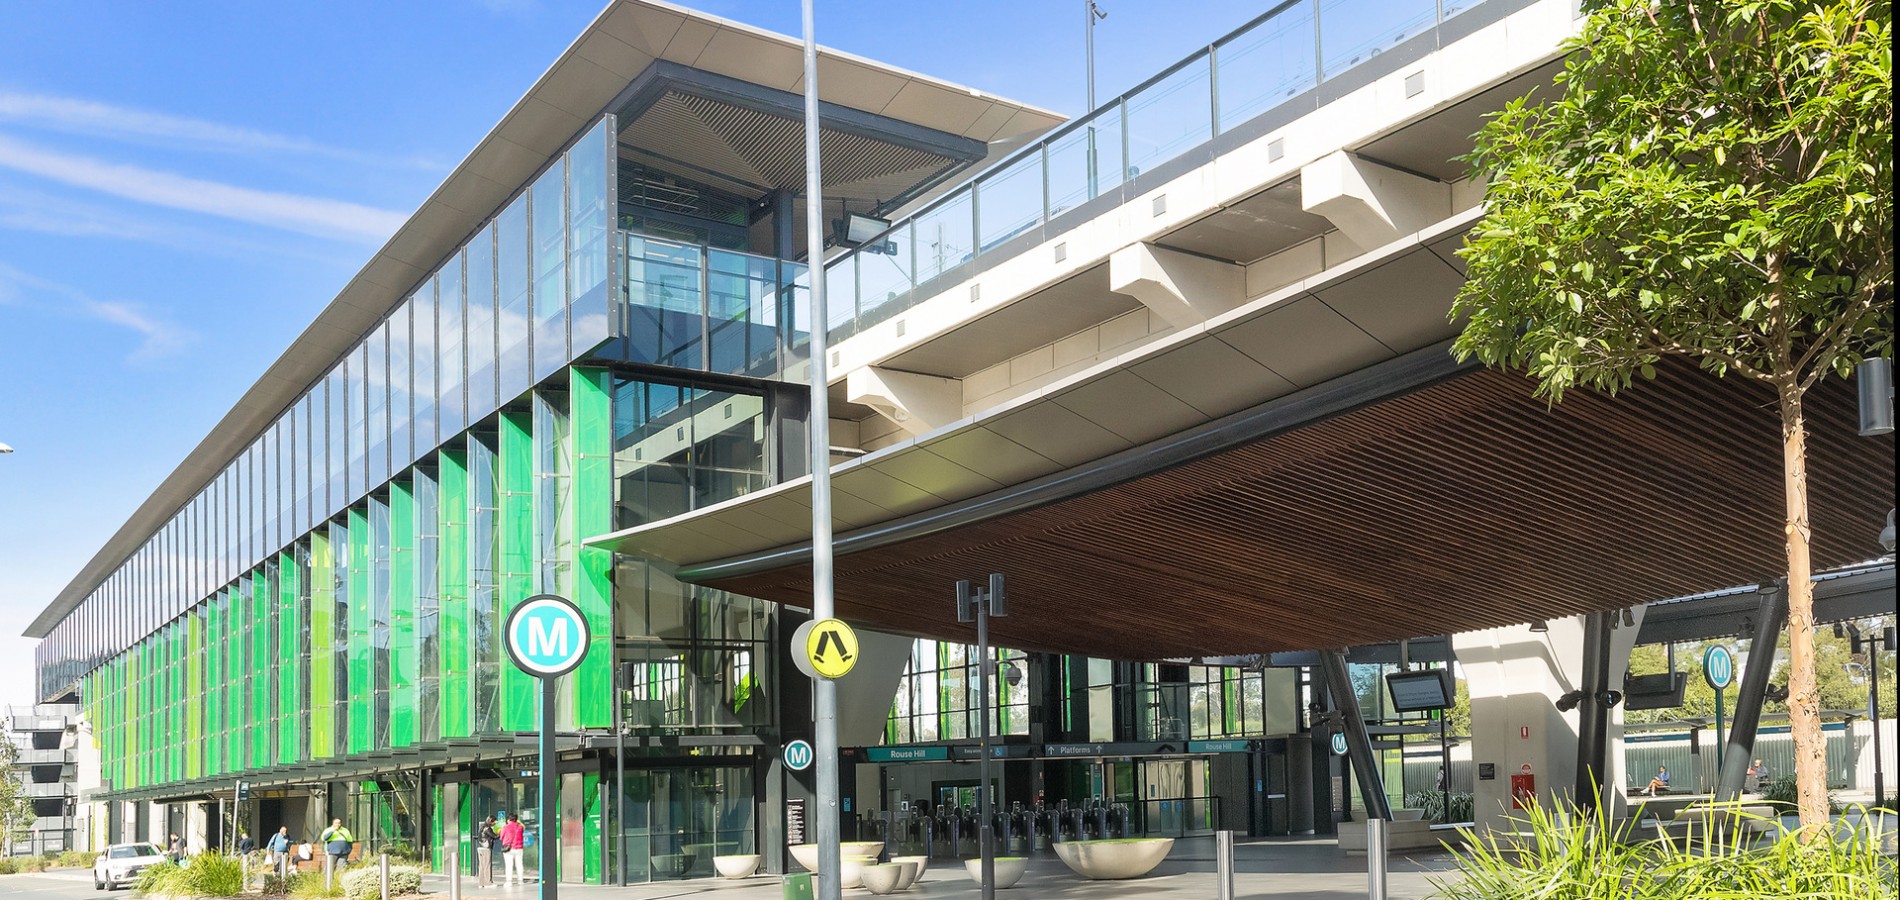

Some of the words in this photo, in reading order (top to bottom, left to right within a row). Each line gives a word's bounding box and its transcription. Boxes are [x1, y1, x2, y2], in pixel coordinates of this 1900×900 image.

[528, 616, 568, 657] M
[1713, 656, 1727, 679] M
[1060, 746, 1091, 754] Platforms
[1222, 742, 1232, 750] Hill
[1335, 736, 1346, 750] M
[791, 746, 807, 764] M
[890, 750, 913, 758] Rouse
[913, 749, 926, 758] Hill
